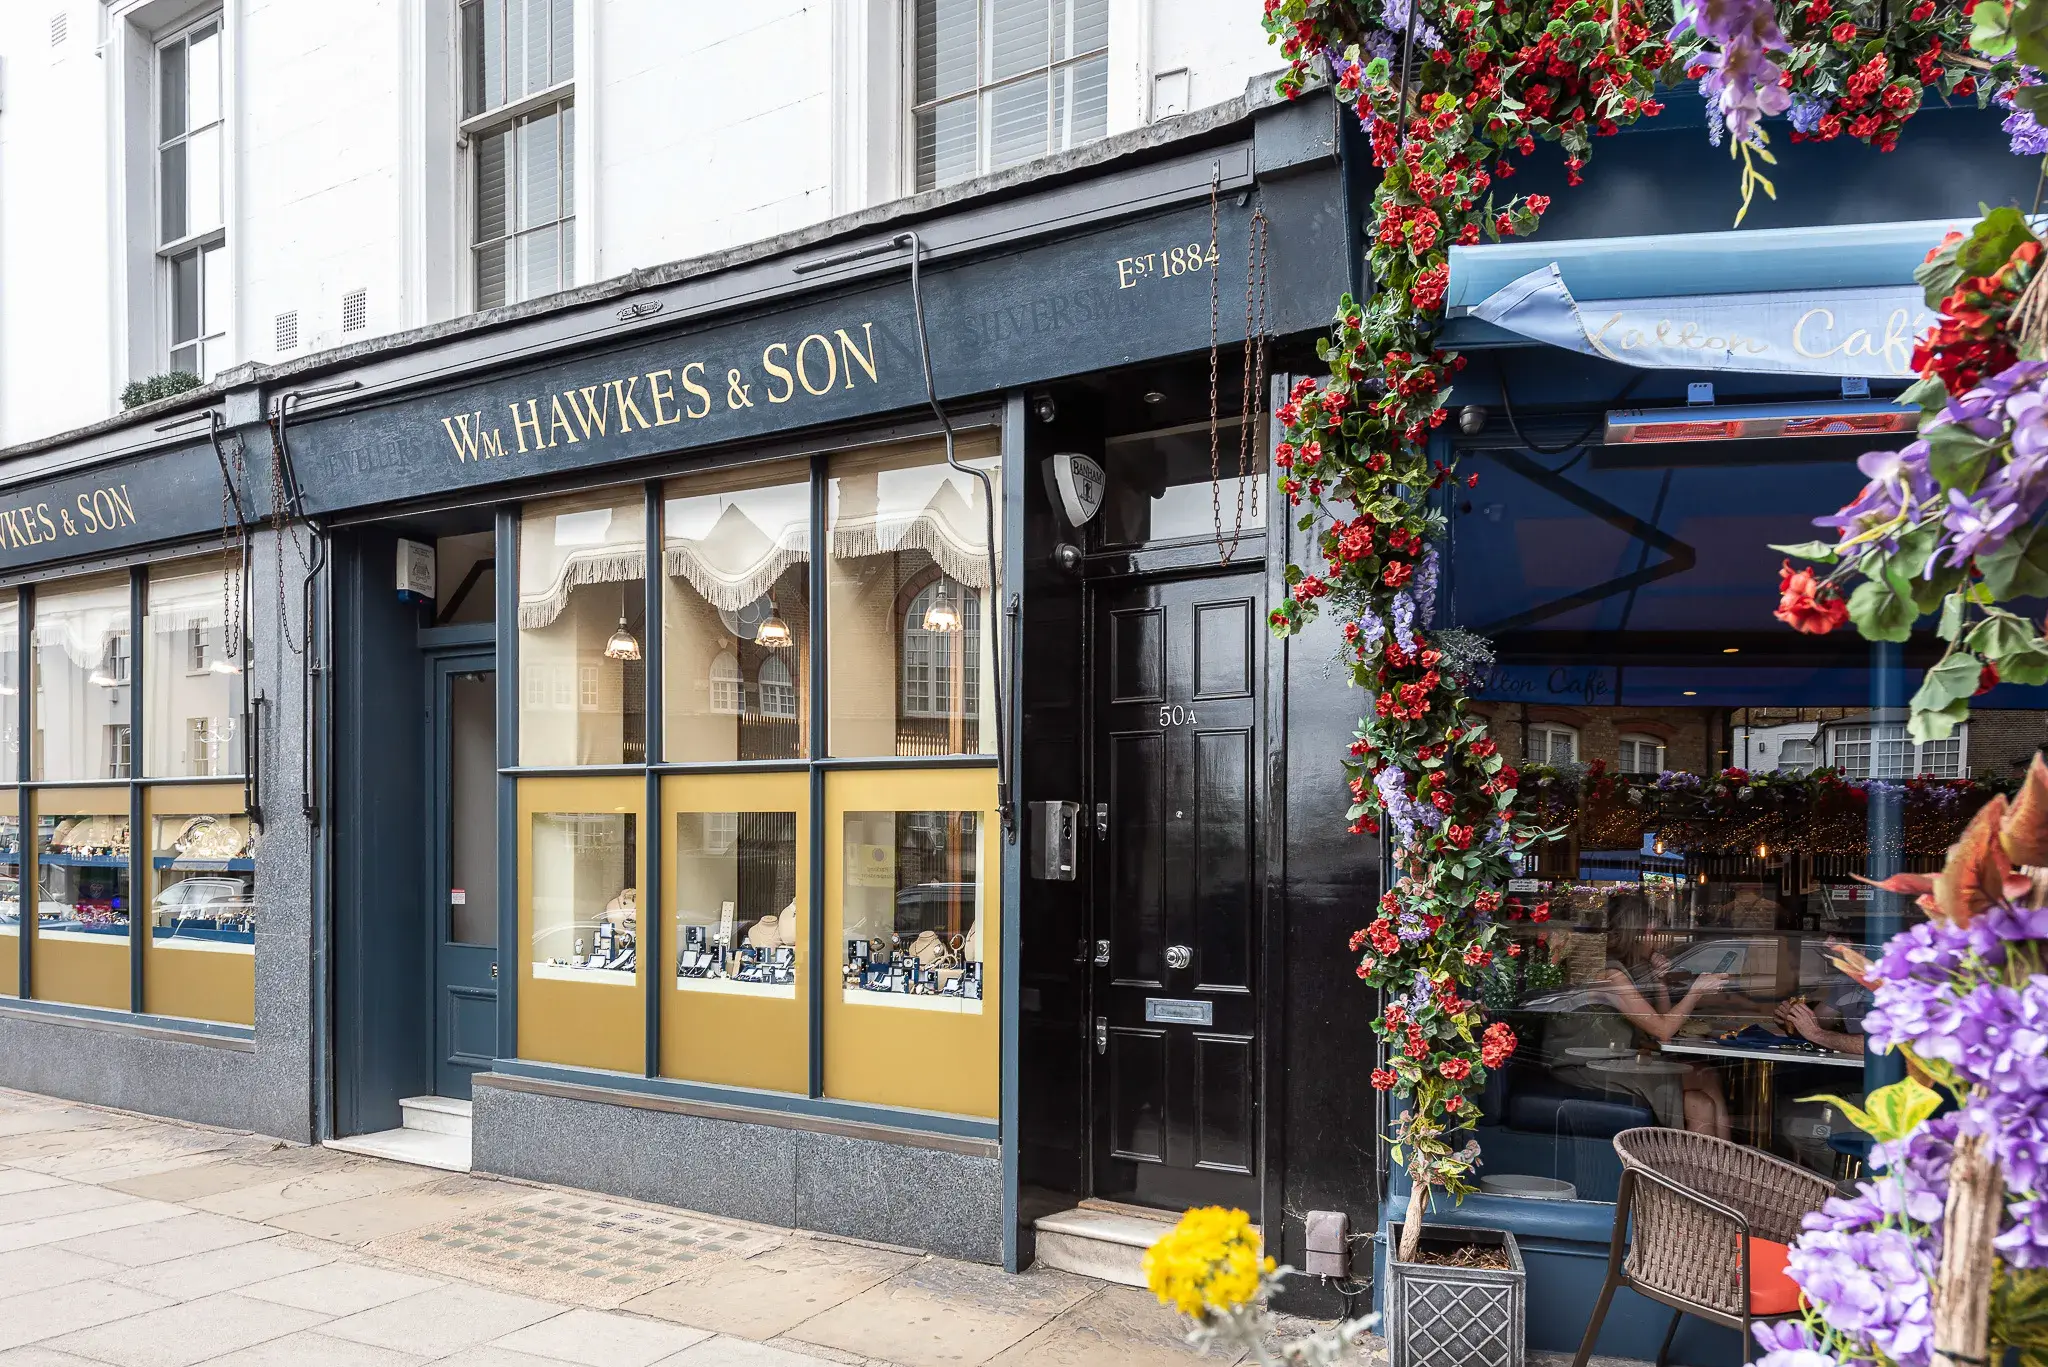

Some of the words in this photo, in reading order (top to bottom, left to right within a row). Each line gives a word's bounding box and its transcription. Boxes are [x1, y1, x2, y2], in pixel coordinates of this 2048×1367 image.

[1160, 239, 1220, 279] 1884
[508, 361, 712, 454] HAWKES
[727, 369, 754, 411] &
[763, 322, 879, 404] SON
[1072, 459, 1103, 485] BANHAM
[60, 508, 78, 536] &
[77, 484, 137, 534] SON
[1159, 705, 1198, 727] 50A
